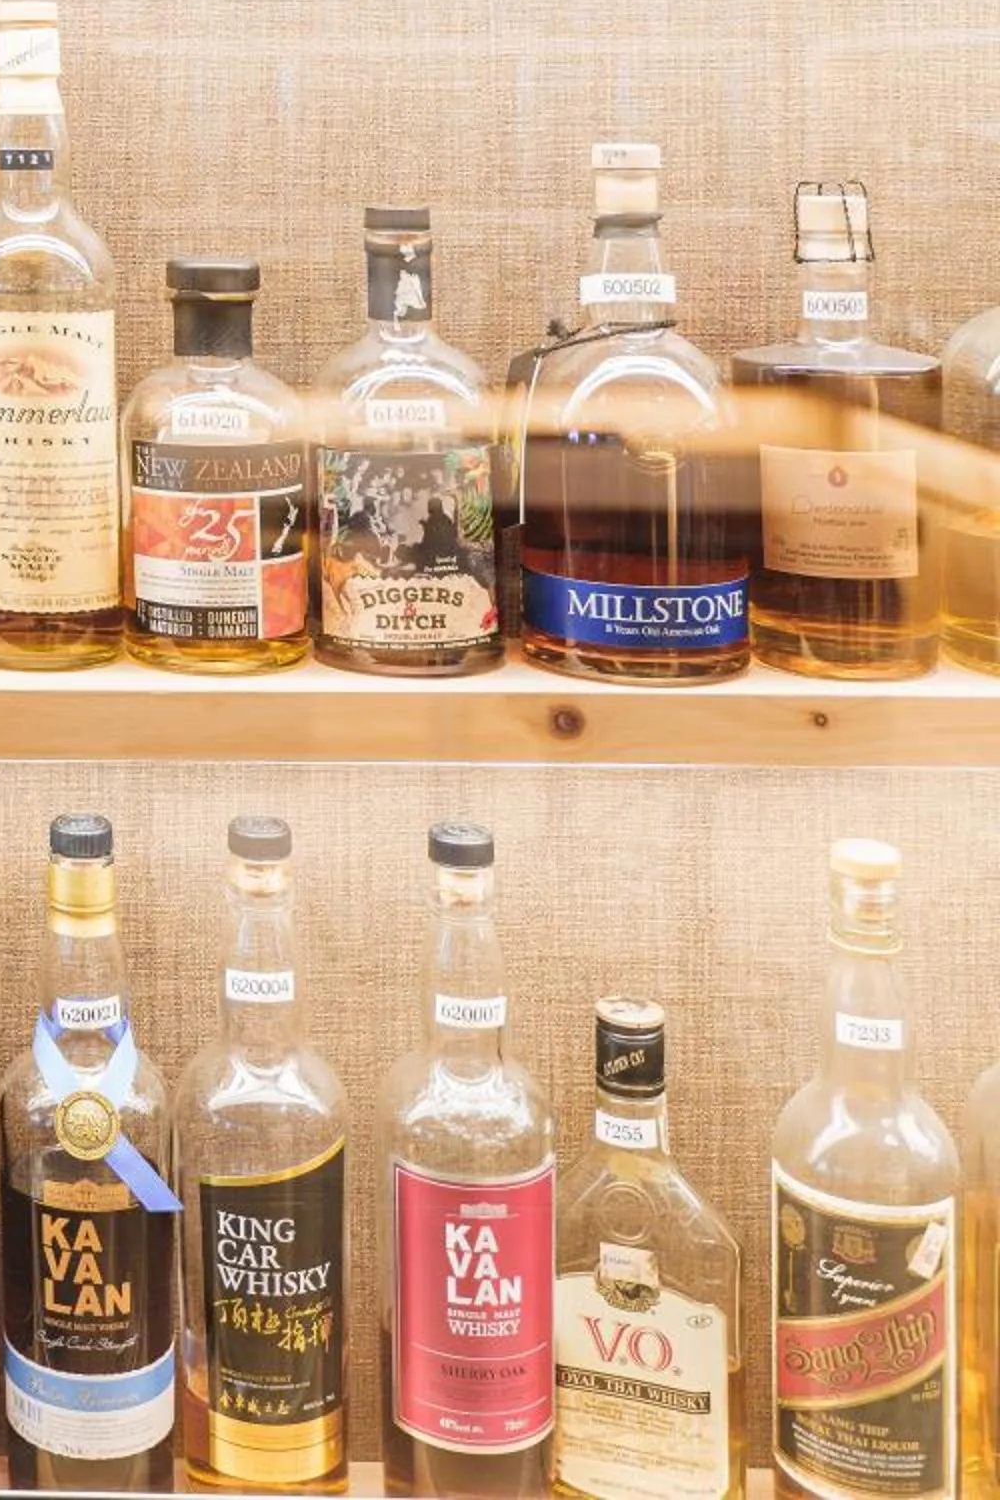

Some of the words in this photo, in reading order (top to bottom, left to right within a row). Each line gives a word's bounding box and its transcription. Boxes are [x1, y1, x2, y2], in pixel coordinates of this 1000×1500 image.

[177, 411, 242, 431] 614020
[372, 404, 437, 423] 614021
[135, 455, 187, 479] NEW
[195, 453, 302, 481] ZEALAND
[189, 508, 255, 562] 25
[359, 586, 465, 609] DIGGERS
[403, 602, 417, 617] &
[567, 588, 745, 624] MILLSTONE
[206, 611, 257, 626] DUNEDIN
[375, 613, 447, 631] DITCH
[230, 978, 290, 996] 620004
[40, 1213, 104, 1254] KA
[215, 1210, 296, 1244] KING
[445, 1221, 498, 1253] KA
[42, 1246, 105, 1284] VA
[216, 1238, 281, 1270] CAR
[446, 1249, 499, 1280] VA
[216, 1261, 333, 1298] WHISKY
[446, 1275, 522, 1307] LAN
[815, 1257, 896, 1295] Superior
[43, 1281, 132, 1317] LAN
[447, 1319, 522, 1338] WHISKY
[605, 1373, 642, 1394] THAI
[647, 1381, 708, 1407] WHISKY
